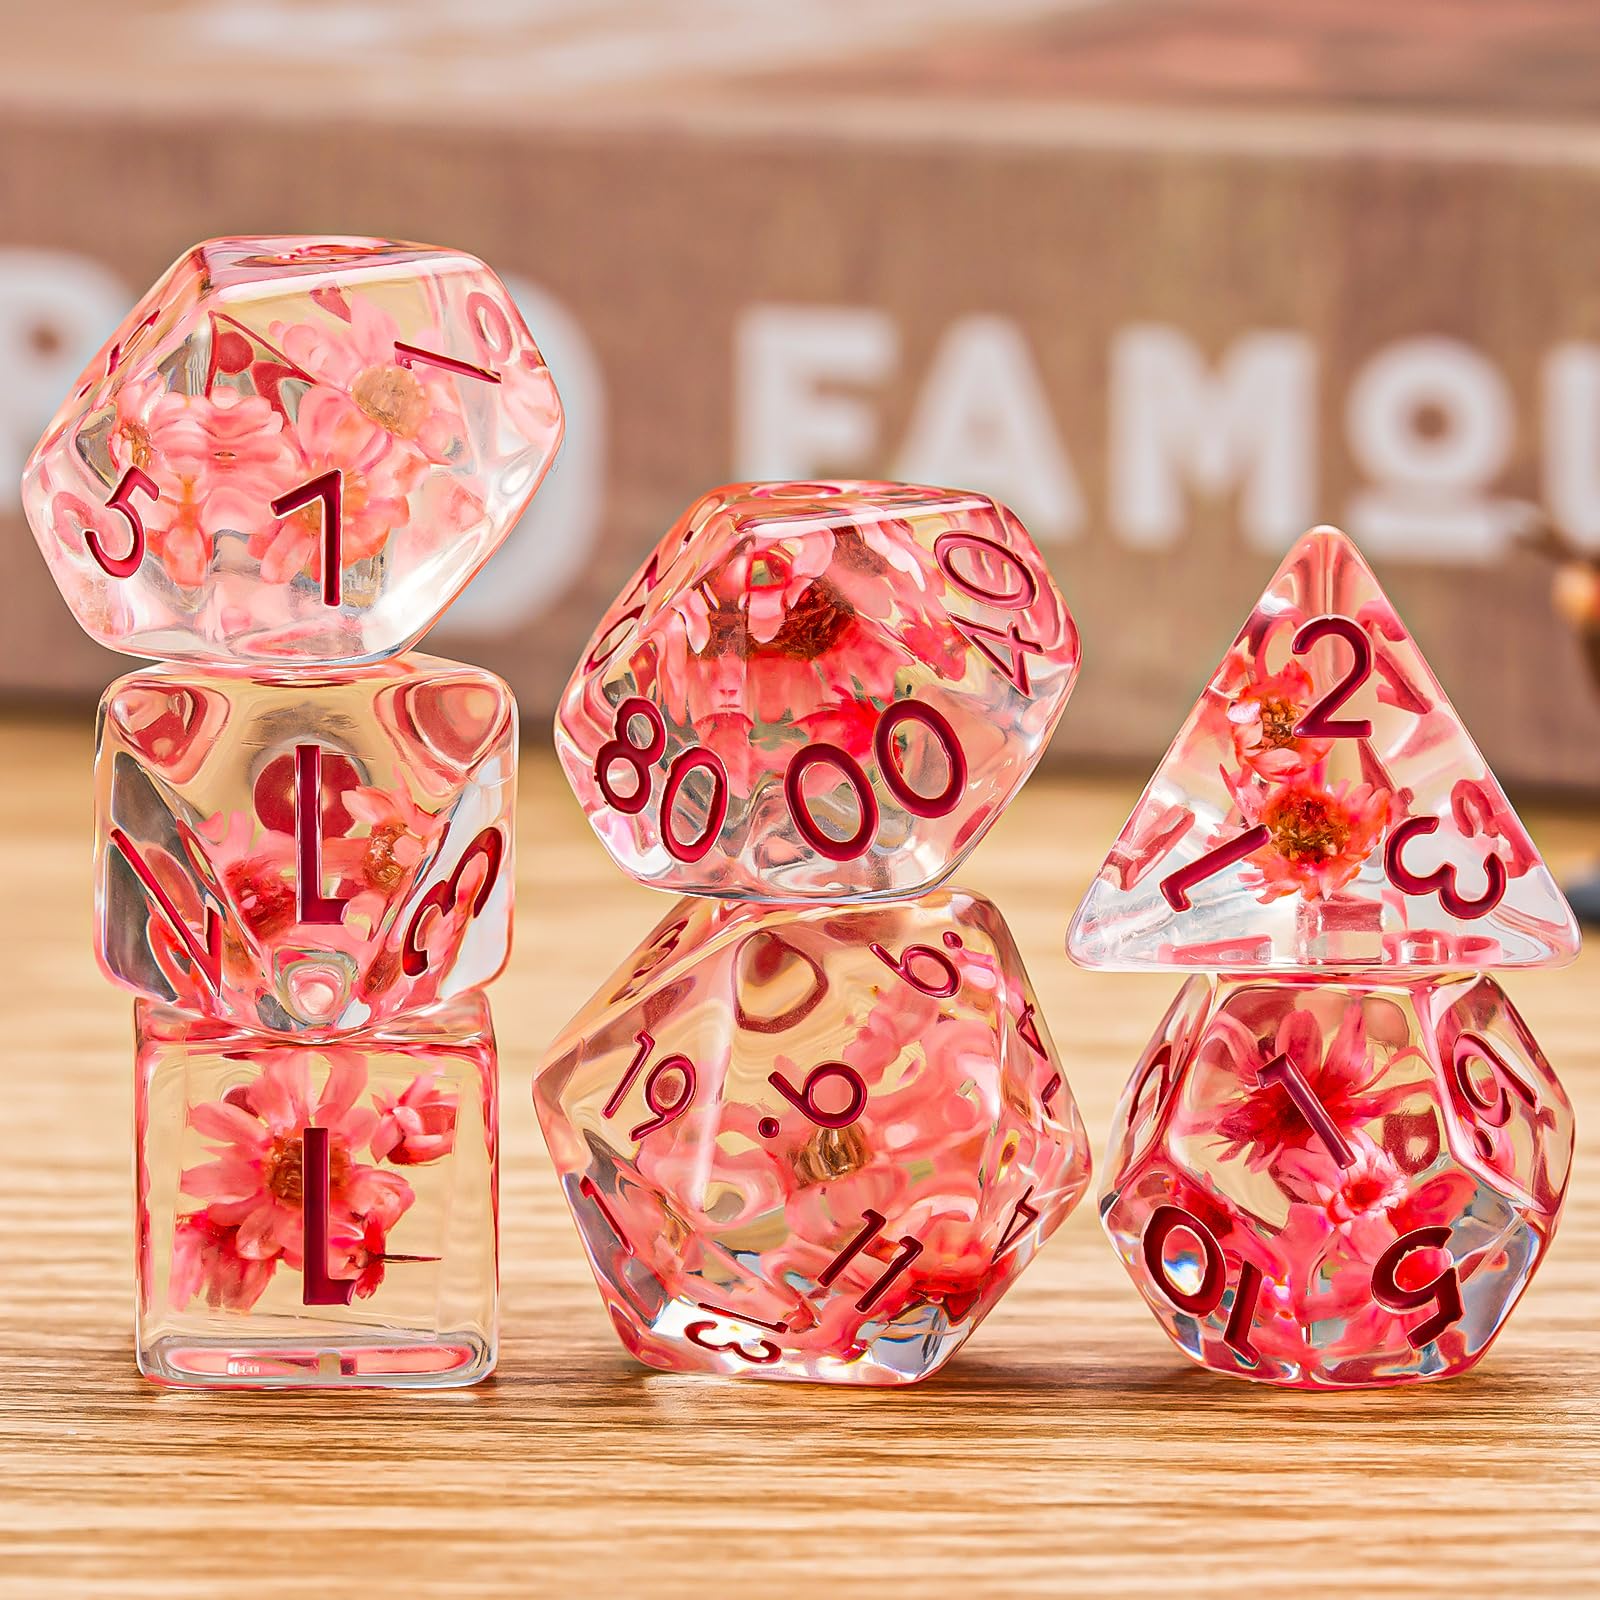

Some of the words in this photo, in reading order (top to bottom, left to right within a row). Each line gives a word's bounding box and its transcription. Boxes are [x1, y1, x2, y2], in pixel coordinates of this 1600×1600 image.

[83, 466, 161, 578] 5
[1291, 615, 1373, 739] 2
[594, 697, 729, 863] 80
[784, 699, 968, 861] 00
[1159, 823, 1273, 914] 1
[1384, 815, 1507, 920] 3
[601, 1030, 697, 1142] 19
[817, 1208, 925, 1313] 11
[1142, 1204, 1263, 1367] 10
[1371, 1226, 1465, 1350] 5
[684, 1302, 789, 1364] 13
